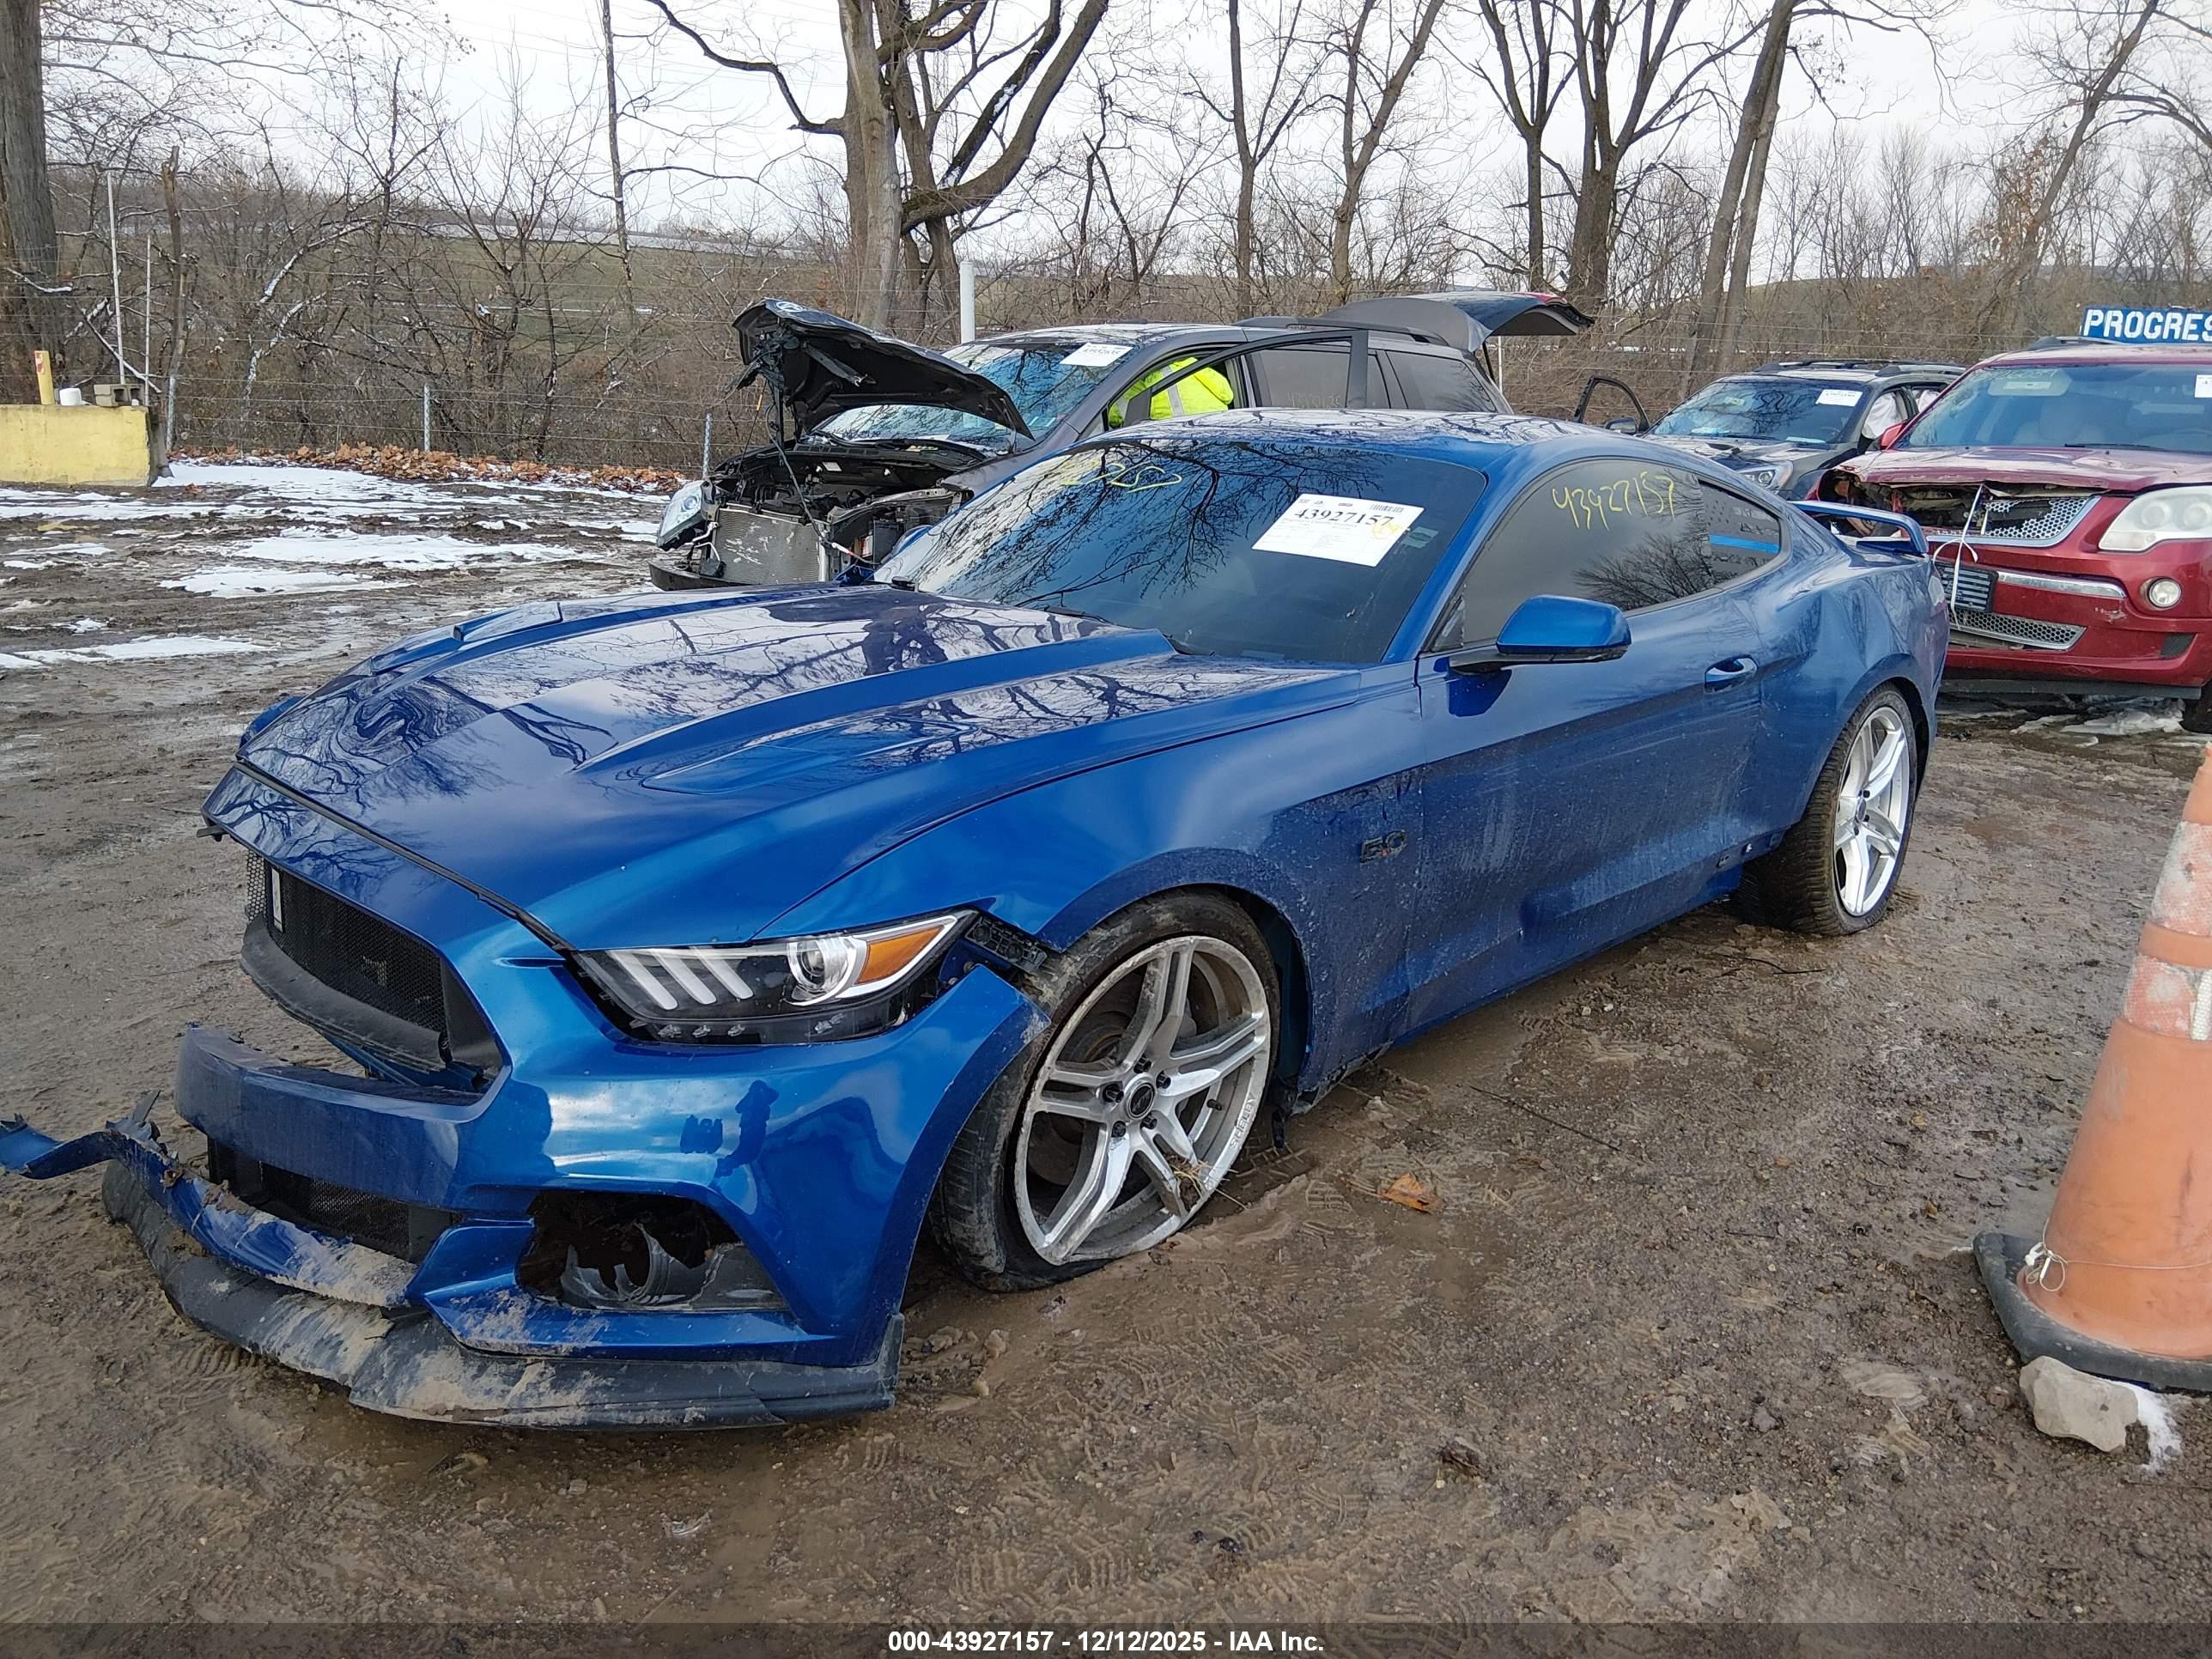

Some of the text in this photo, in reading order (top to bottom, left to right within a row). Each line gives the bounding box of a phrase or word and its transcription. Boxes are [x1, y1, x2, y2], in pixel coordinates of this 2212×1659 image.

[1294, 507, 1395, 526] 43927157
[1552, 471, 1675, 531] 43927157
[1229, 1091, 1256, 1149] SHELBY
